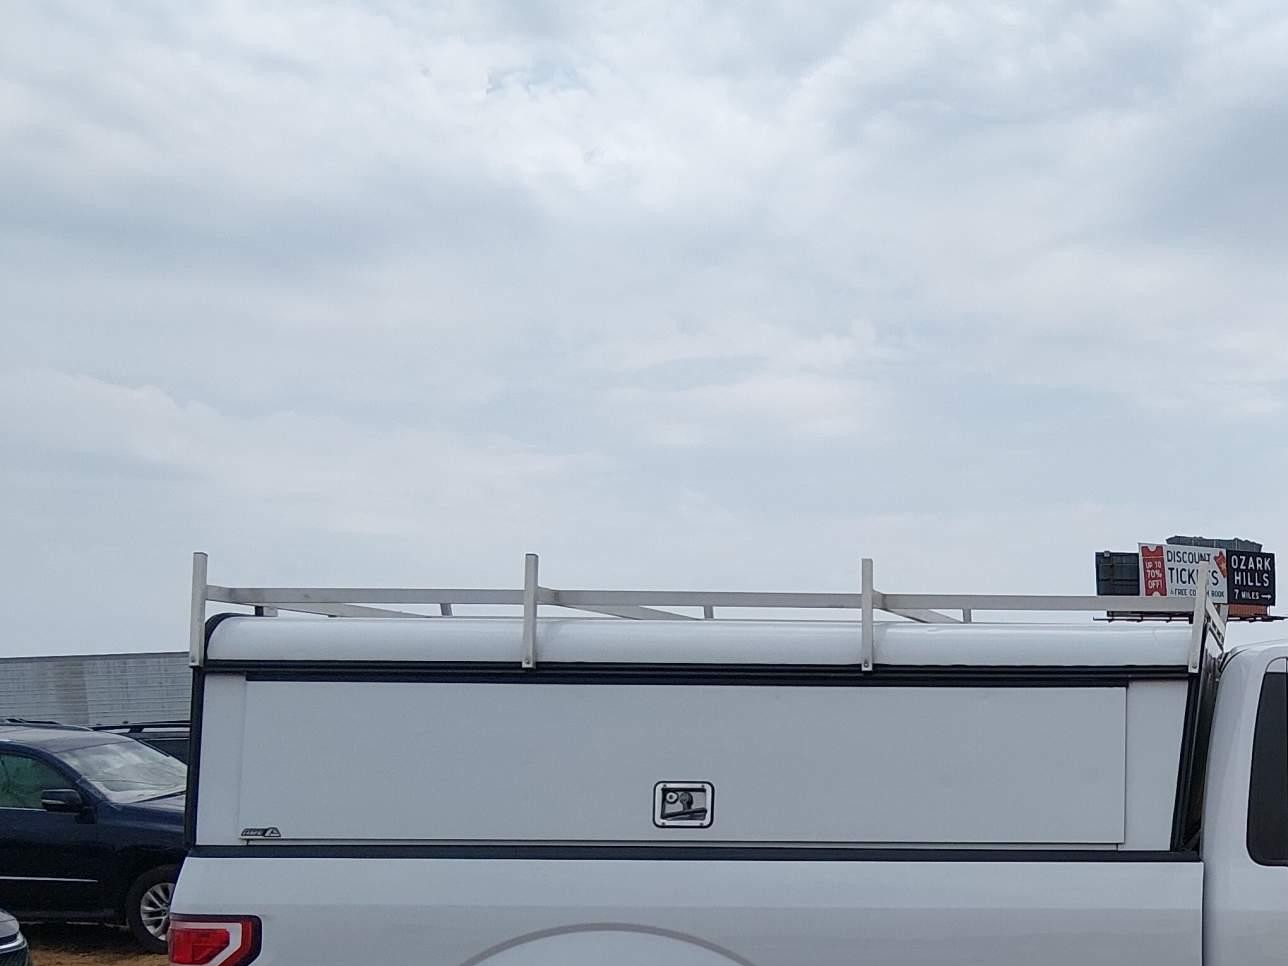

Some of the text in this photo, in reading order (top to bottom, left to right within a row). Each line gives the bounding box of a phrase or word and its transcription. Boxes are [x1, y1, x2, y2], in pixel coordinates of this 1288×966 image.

[1167, 550, 1211, 564] DISCOUNT
[1231, 555, 1271, 571] OZARK
[1146, 569, 1162, 579] 70%
[1168, 567, 1219, 586] TICKS
[1234, 571, 1270, 587] HILLS
[1234, 589, 1260, 600] 7 MILES
